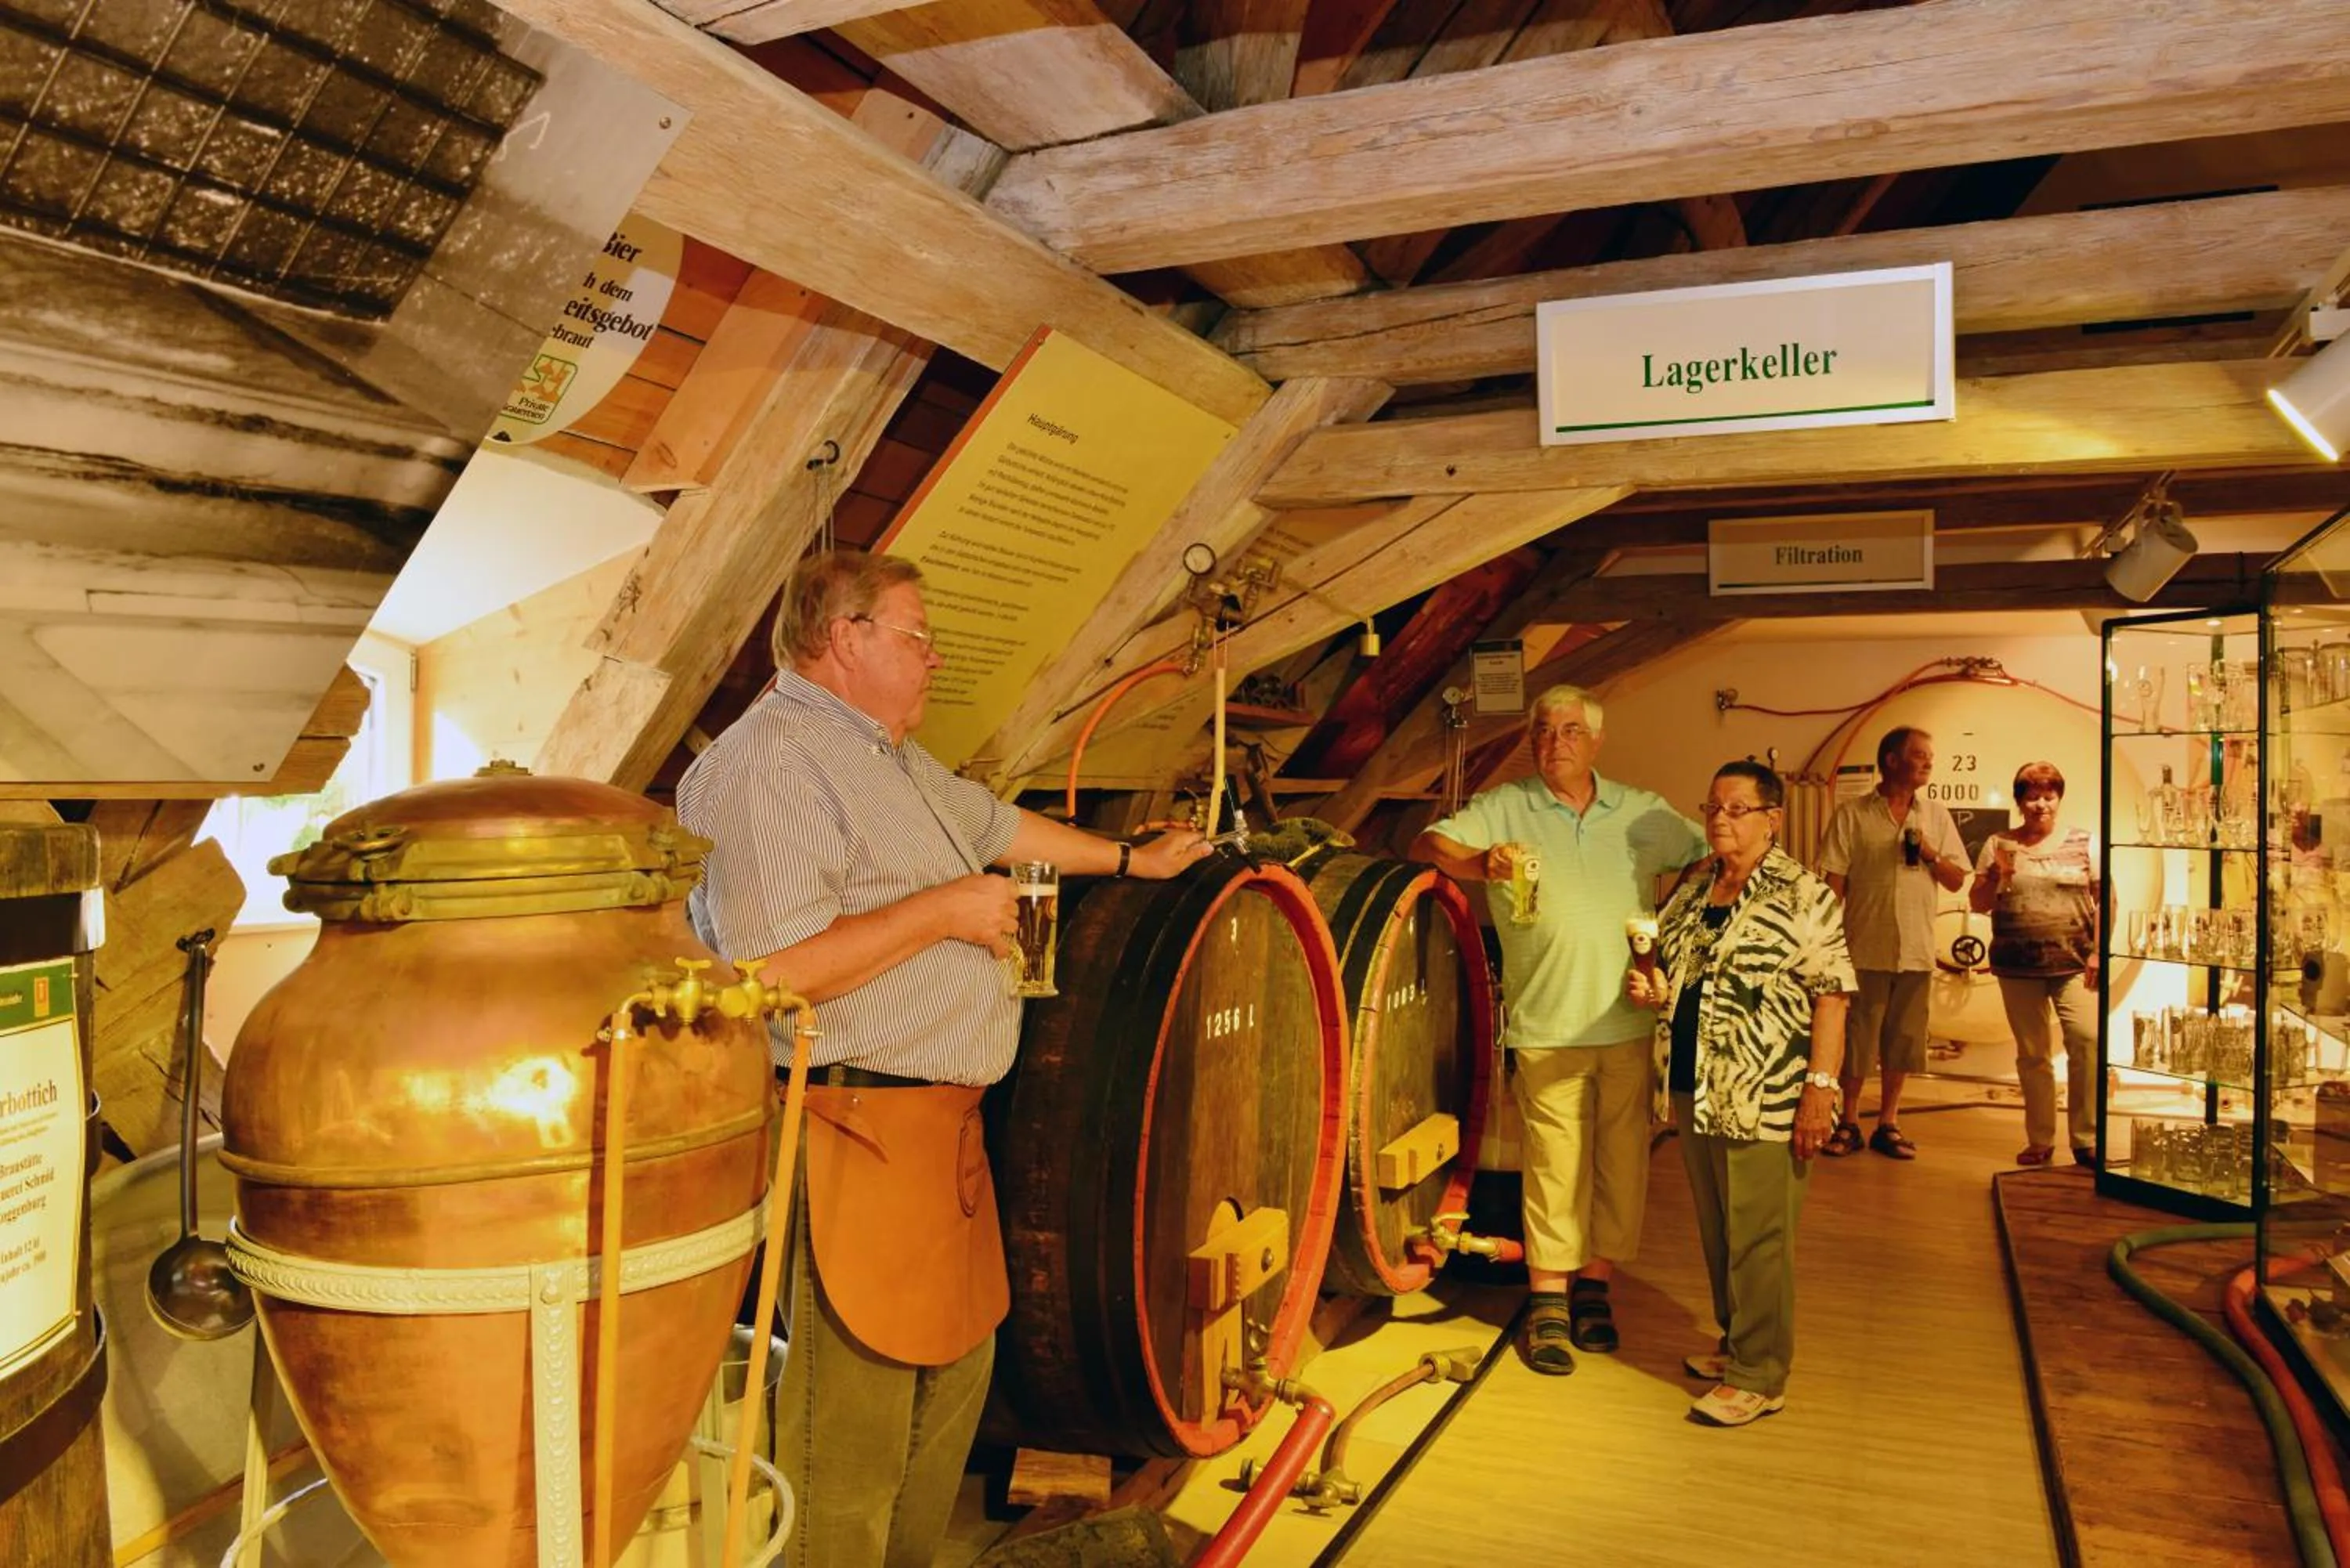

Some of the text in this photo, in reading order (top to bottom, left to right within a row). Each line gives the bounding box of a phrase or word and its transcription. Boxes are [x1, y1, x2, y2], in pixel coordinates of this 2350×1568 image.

[600, 280, 634, 302] dem
[563, 297, 653, 341] eitsgebot
[552, 323, 595, 349] braut
[1641, 342, 1837, 394] Lagerkeller
[1027, 413, 1079, 445] Hauptgärung
[1775, 544, 1864, 565] Filtration
[1952, 755, 1976, 771] 23
[1928, 783, 1979, 800] 6000
[1231, 917, 1237, 941] 3
[1206, 1007, 1240, 1040] 1256
